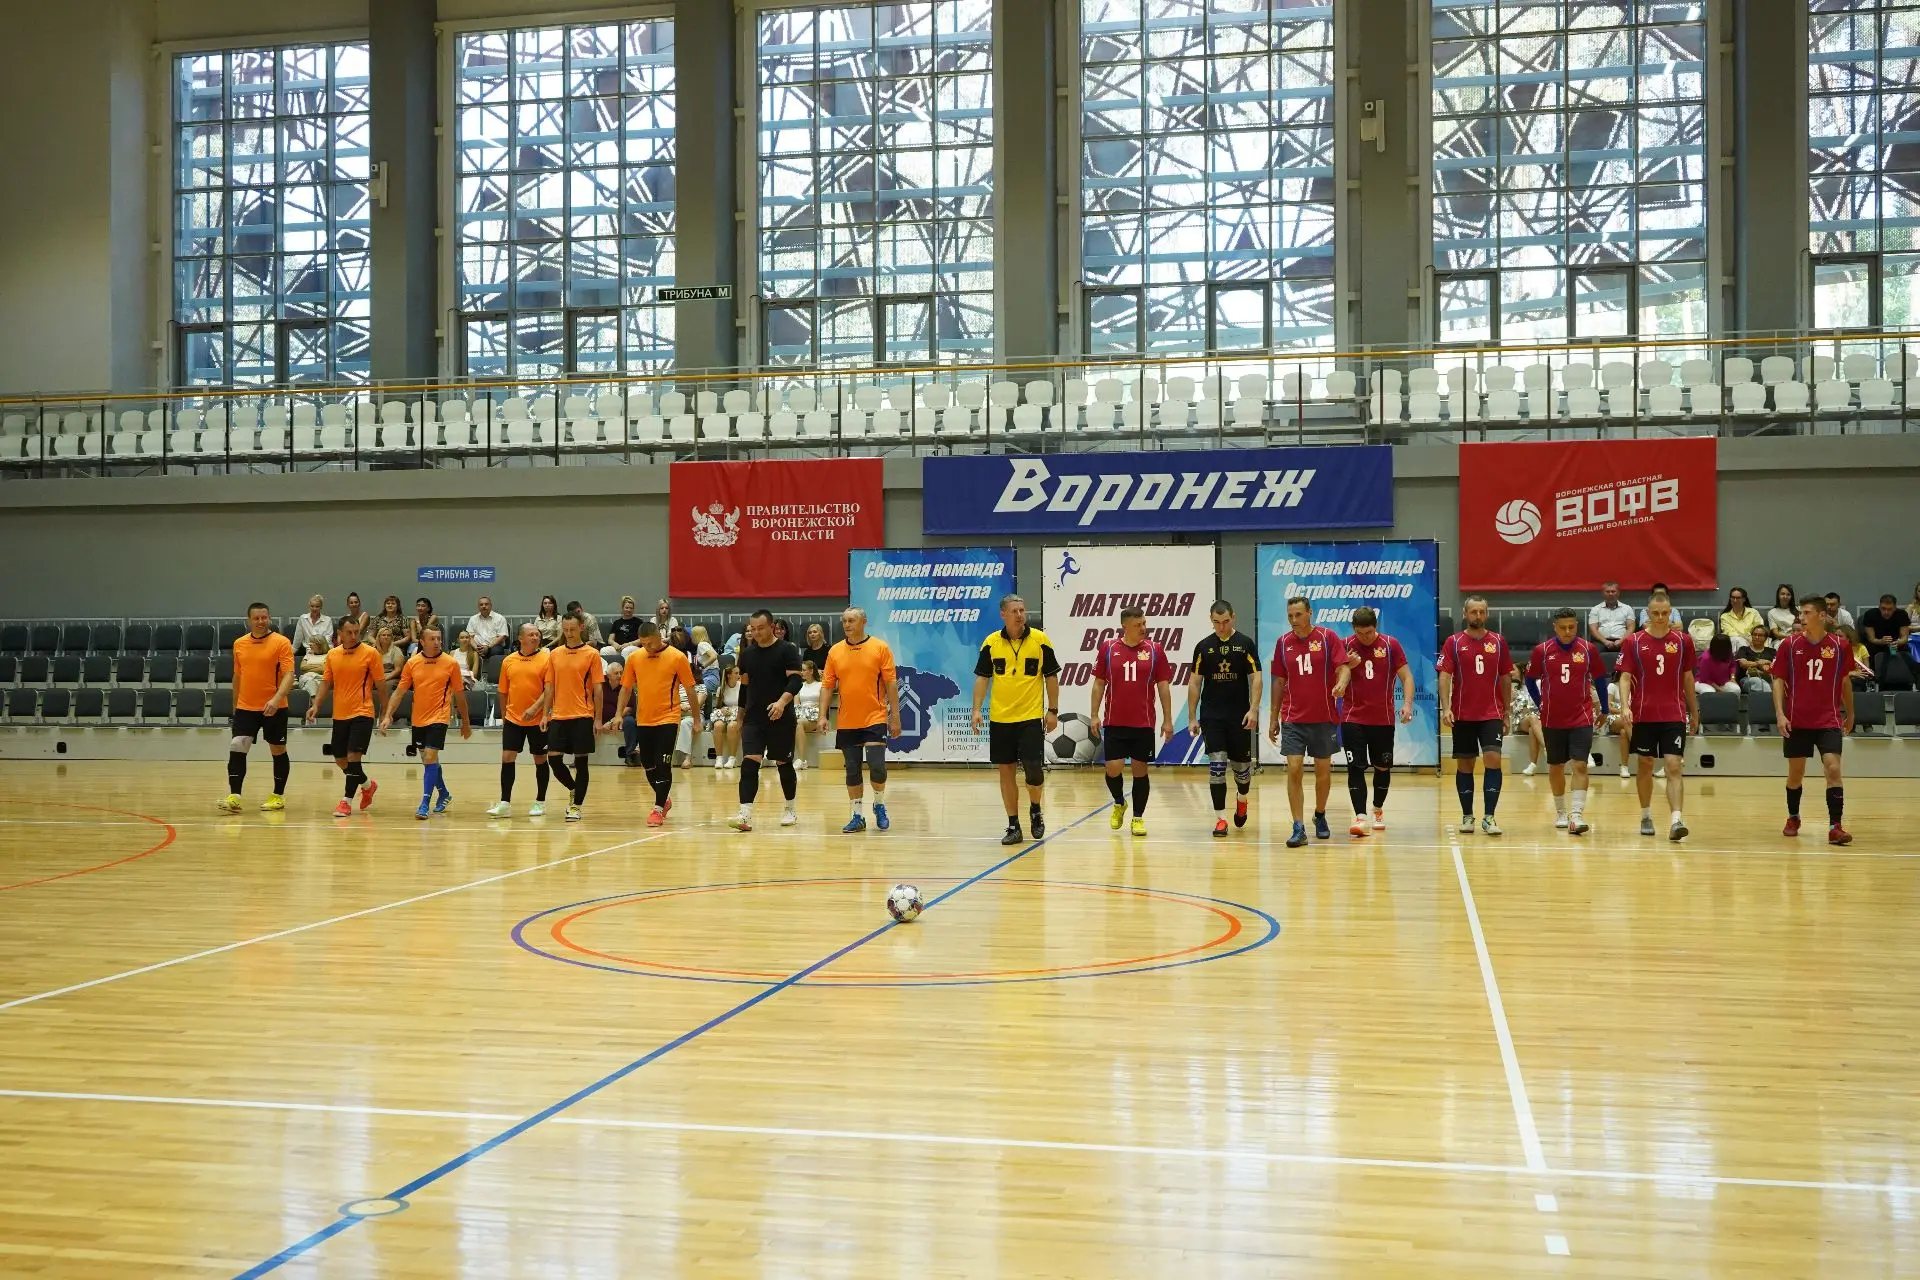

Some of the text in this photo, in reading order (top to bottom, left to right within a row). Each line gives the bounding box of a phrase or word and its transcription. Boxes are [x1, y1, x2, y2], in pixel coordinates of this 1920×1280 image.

[664, 287, 728, 299] ТРИБУНА М
[1556, 474, 1662, 499] ВОРОНЕЖСКАЯ ОБЛАСТНАЯ
[746, 503, 861, 516] ПРАВИТЕЛЬСТВО
[1556, 479, 1679, 530] ВОФВ
[751, 514, 855, 529] ВОРОНЕЖСКОЙ
[1556, 515, 1654, 538] ФЕДЕРАЦИЯ ВОЛЕЙБОЛА
[771, 530, 835, 542] ОБЛАСТИ
[435, 569, 470, 579] ТРИБУНА
[864, 562, 1005, 579] Сборная команда
[1272, 559, 1425, 577] Сборная команда
[877, 585, 991, 601] министерства
[1284, 583, 1413, 600] Острогожского
[888, 609, 980, 624] имущества
[1123, 661, 1137, 681] 11
[1296, 653, 1312, 675] 14
[1365, 660, 1374, 679] 8
[1475, 655, 1484, 675] 6
[1656, 654, 1665, 675] 3
[1807, 659, 1823, 680] 12
[1561, 664, 1570, 683] 5
[1675, 736, 1682, 749] 4
